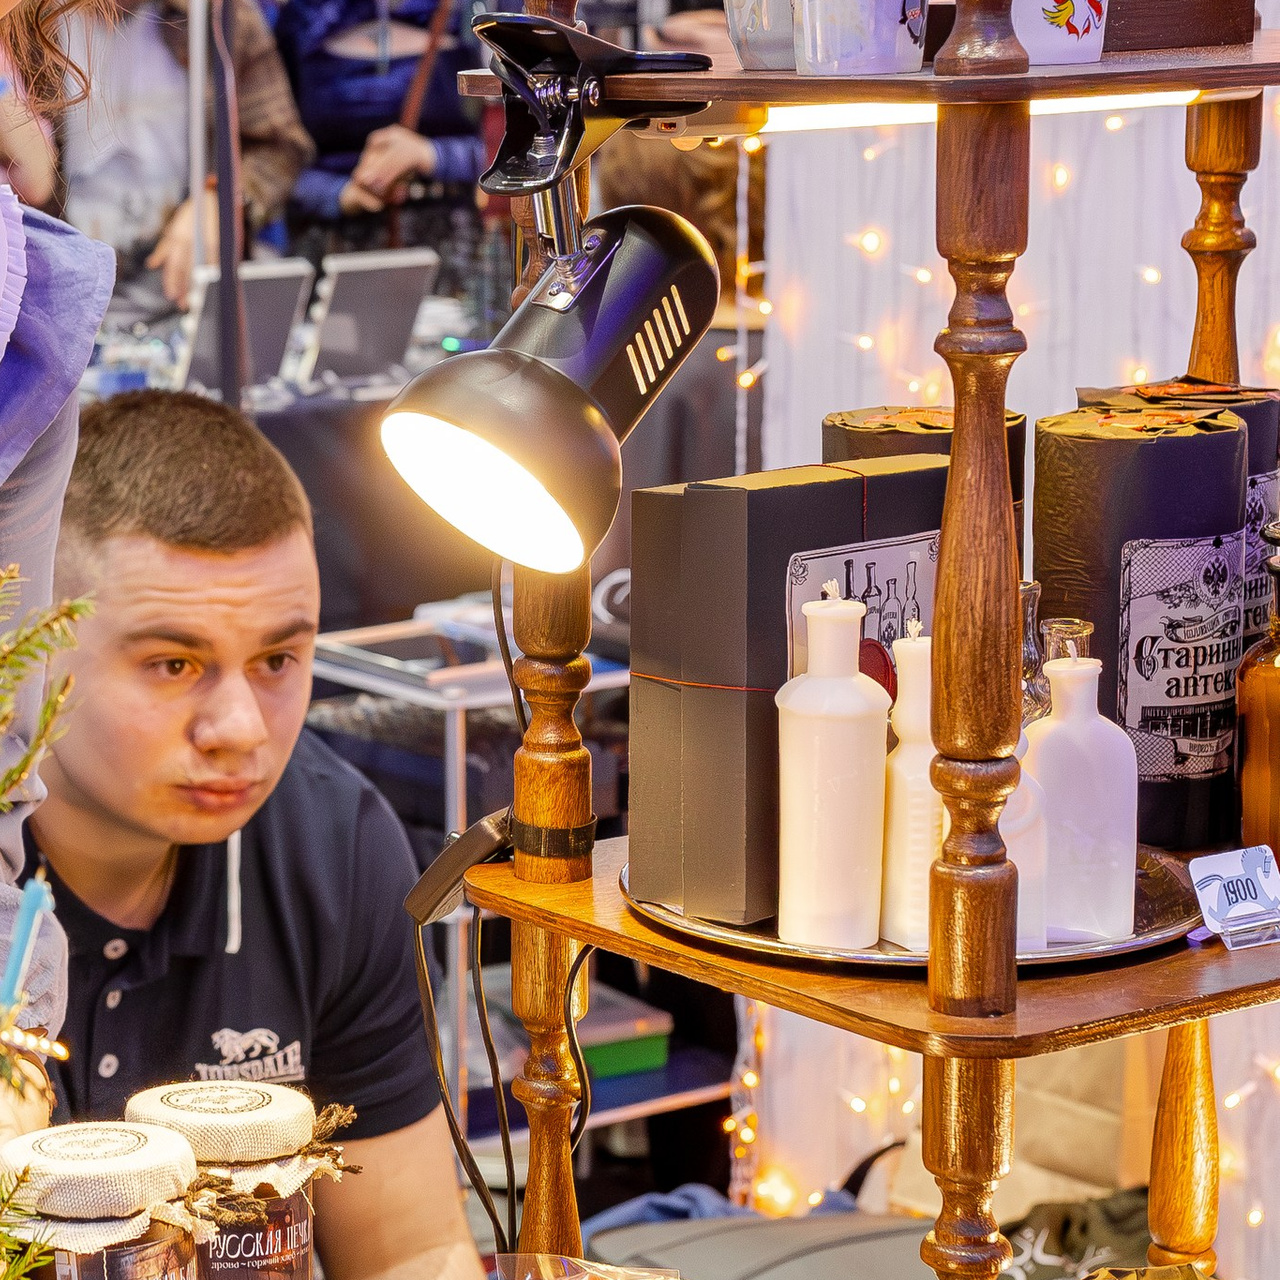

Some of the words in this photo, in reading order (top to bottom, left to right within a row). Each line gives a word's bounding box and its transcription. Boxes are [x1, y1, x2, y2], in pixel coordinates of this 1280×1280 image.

[1133, 635, 1243, 682] Старинн
[1223, 877, 1258, 907] 1900
[208, 1229, 282, 1259] РУССКАЯ
